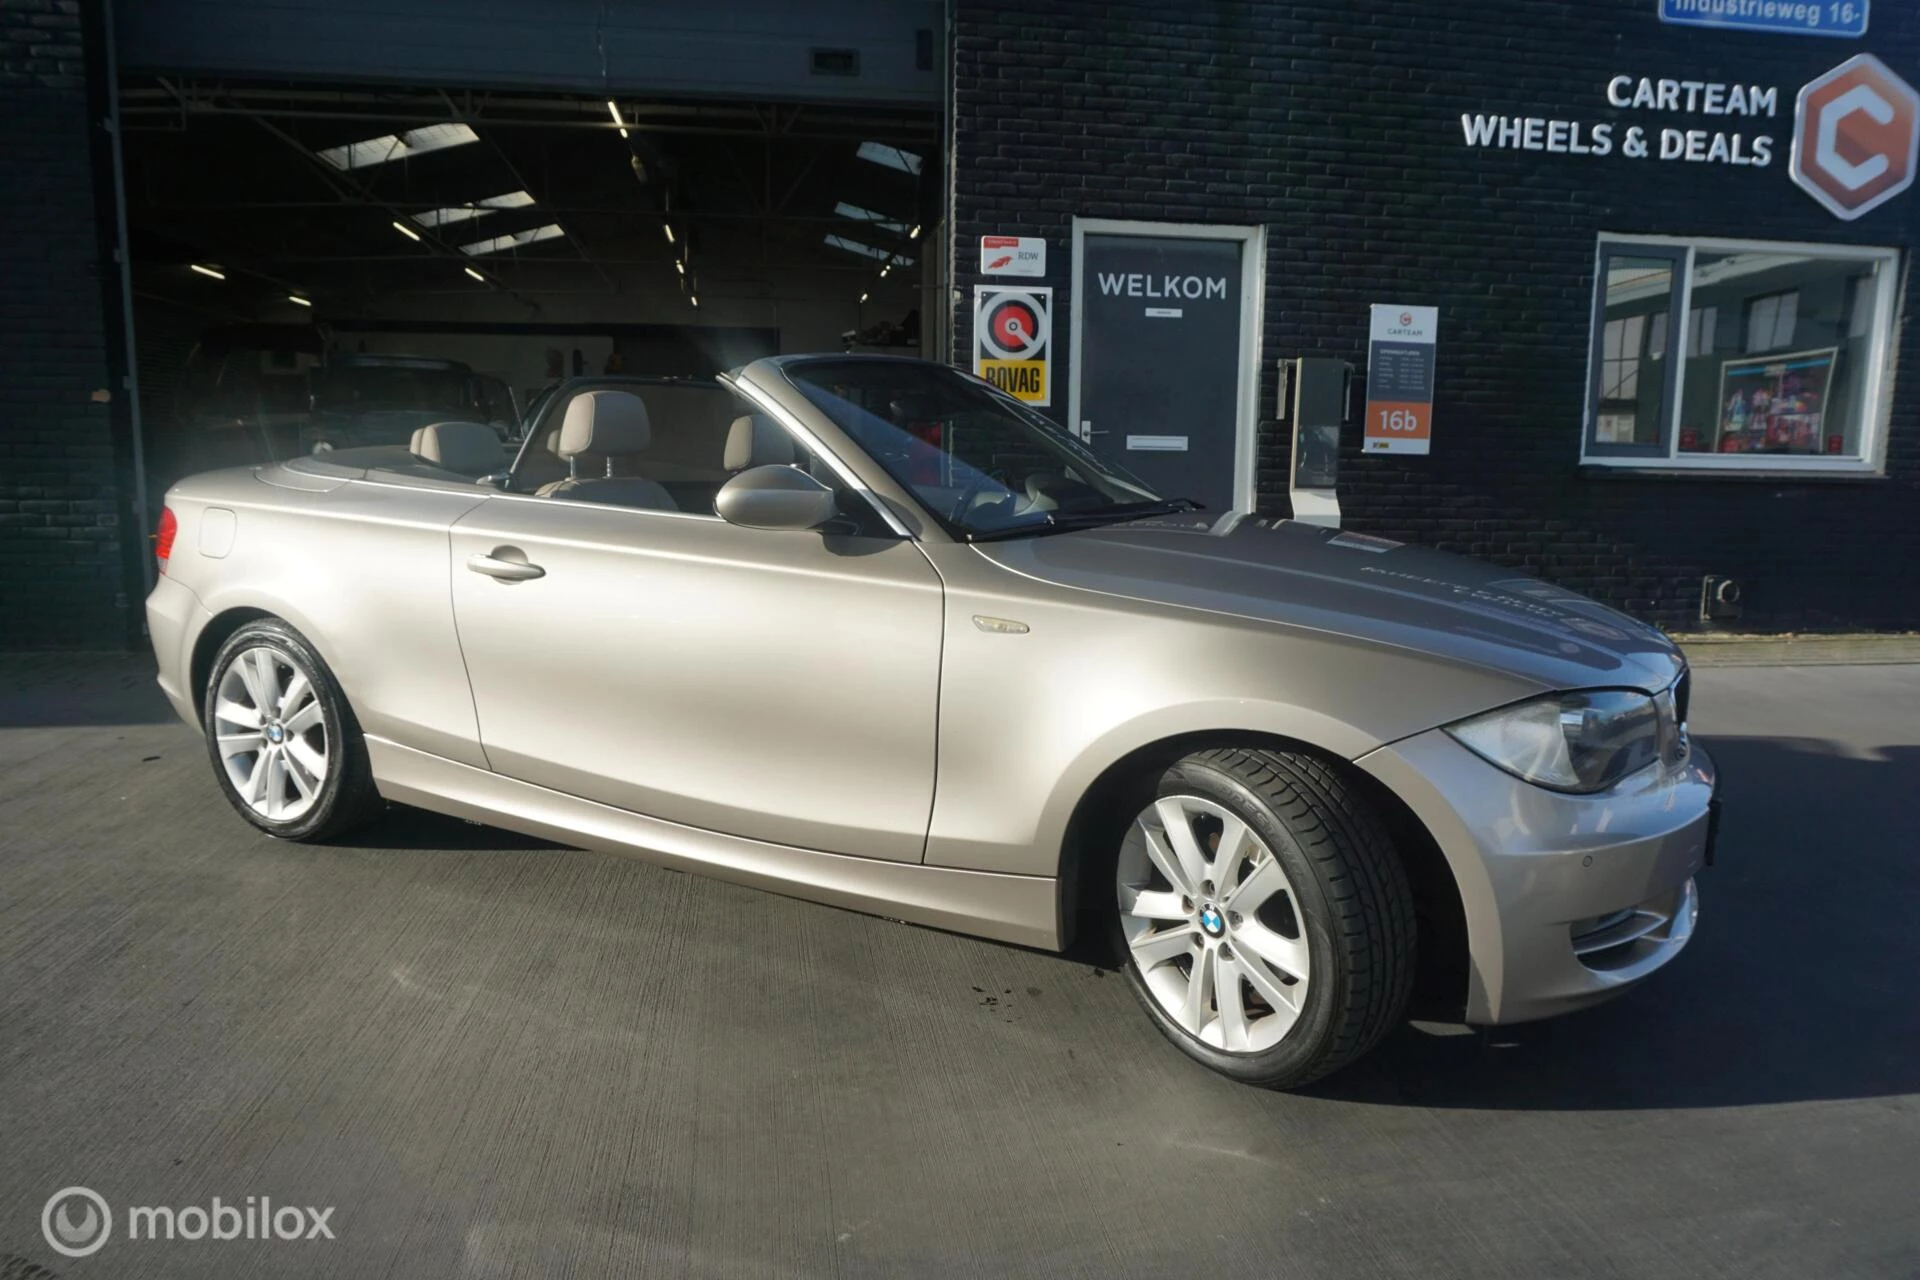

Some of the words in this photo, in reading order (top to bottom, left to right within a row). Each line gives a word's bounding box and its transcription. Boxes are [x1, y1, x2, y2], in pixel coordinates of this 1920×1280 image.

[1607, 75, 1777, 117] CARTEAM
[1461, 113, 1612, 156] WHEELS
[1623, 126, 1648, 158] &
[1660, 128, 1774, 167] DEALS
[1018, 251, 1039, 260] RDW
[1098, 272, 1227, 300] WELKOM
[1379, 409, 1417, 431] 16b
